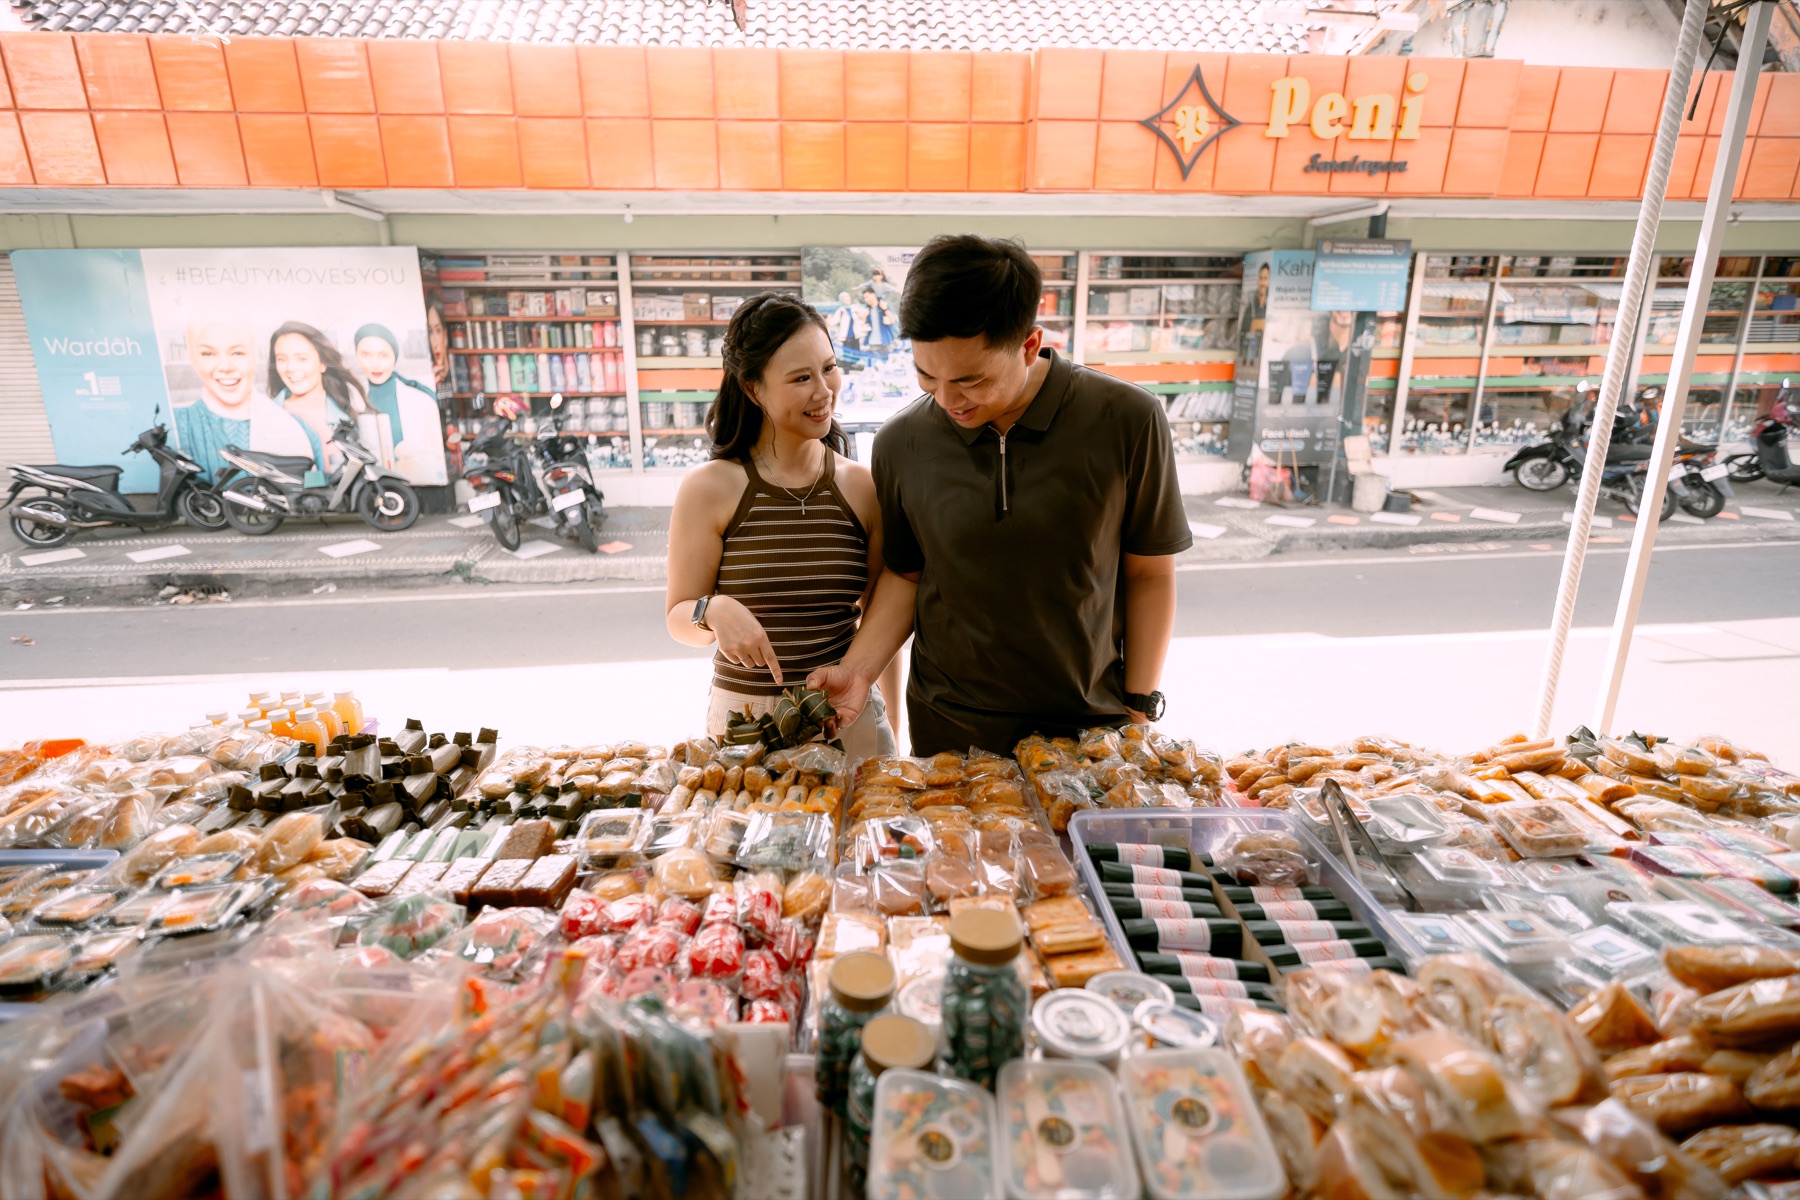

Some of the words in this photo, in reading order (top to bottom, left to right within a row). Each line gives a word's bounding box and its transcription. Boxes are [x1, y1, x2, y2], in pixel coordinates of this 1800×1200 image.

[1264, 72, 1430, 140] Peni
[175, 266, 406, 287] #BEAUTYMOVESYOU
[1277, 259, 1315, 277] Kah
